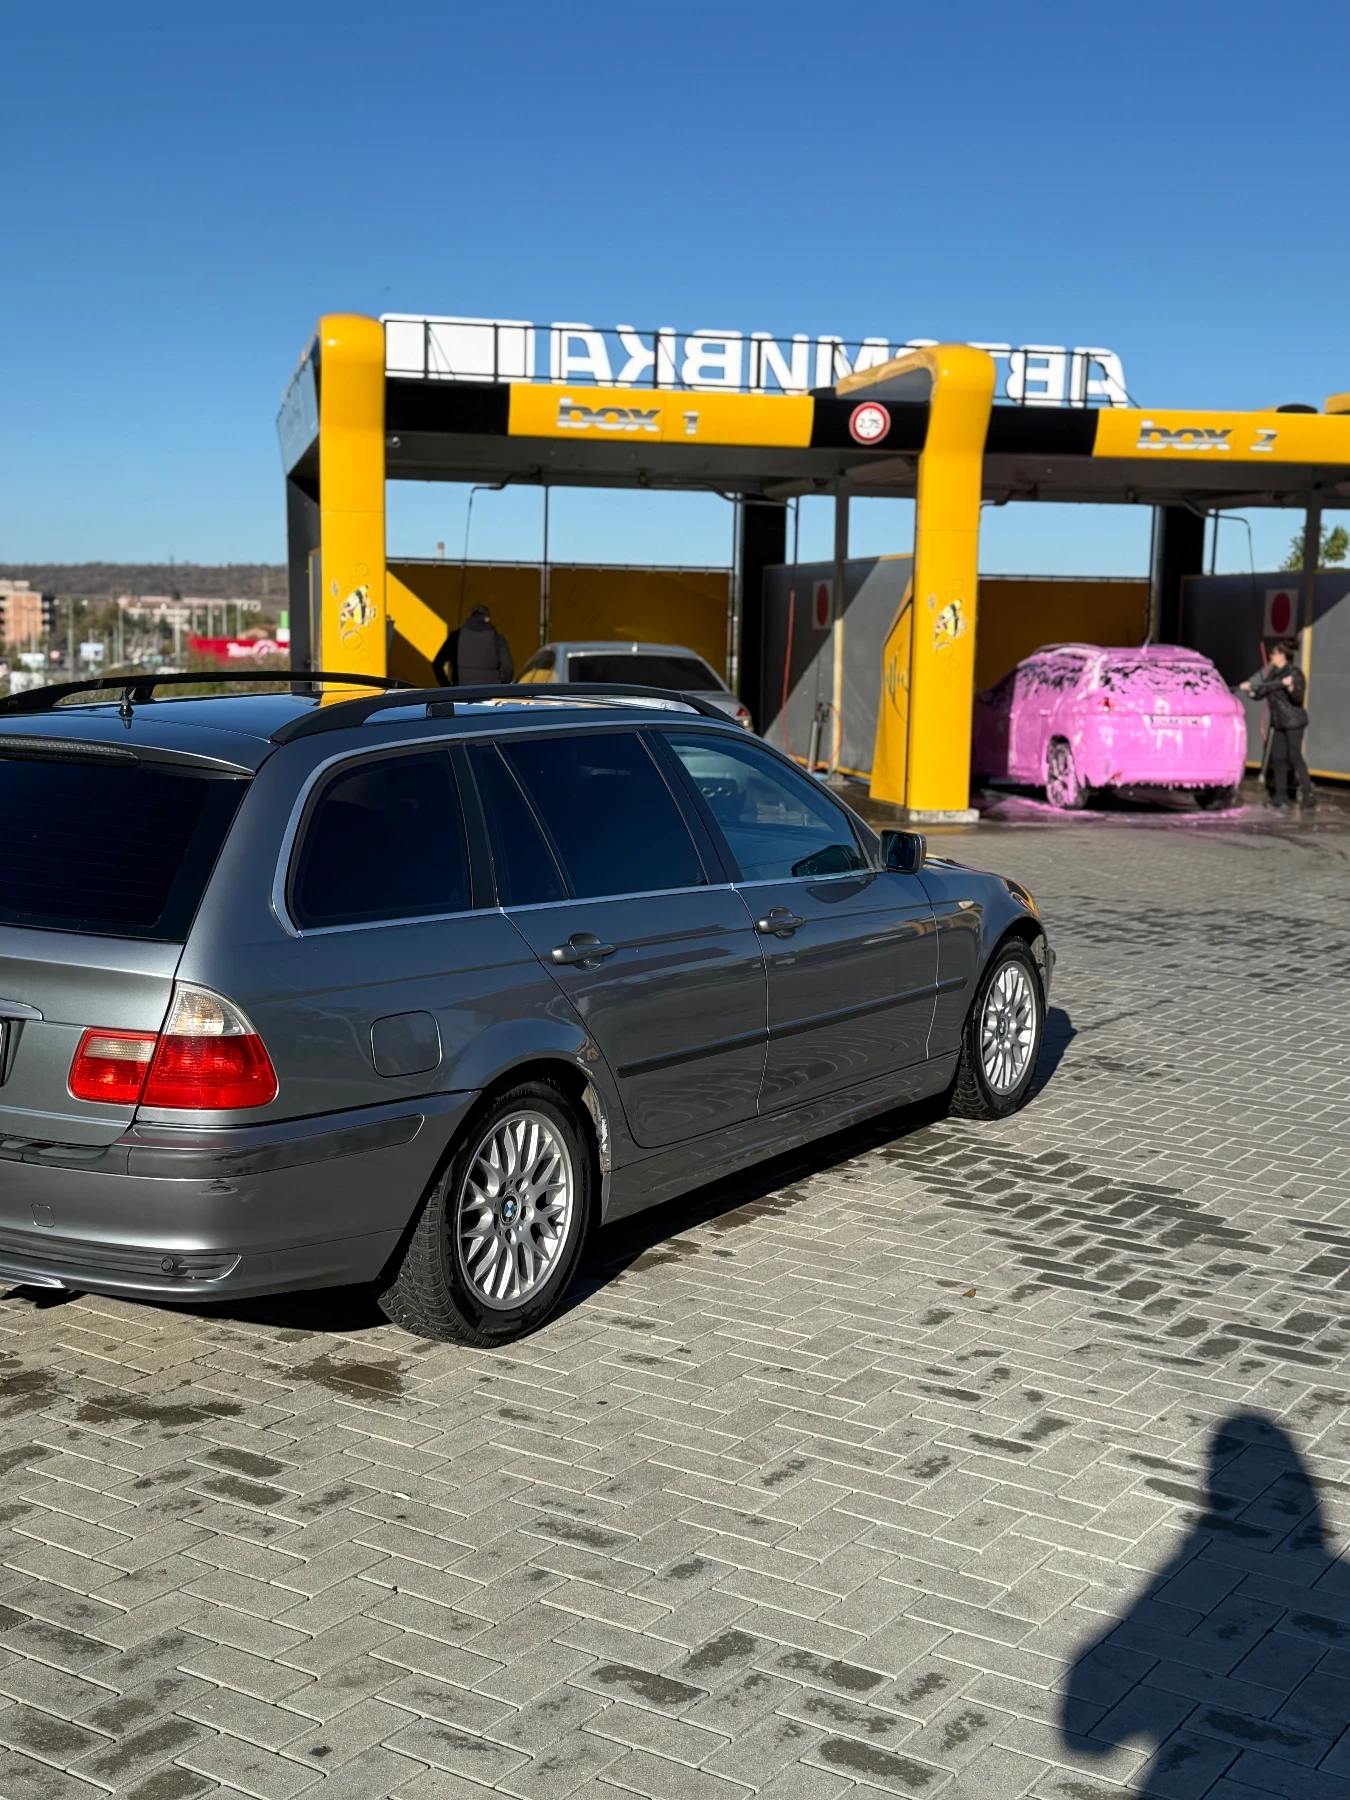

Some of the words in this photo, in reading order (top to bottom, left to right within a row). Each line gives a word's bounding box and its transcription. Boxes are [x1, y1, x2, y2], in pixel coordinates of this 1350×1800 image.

[557, 397, 661, 432] box
[683, 411, 699, 434] 1
[1136, 420, 1233, 450] box
[1249, 428, 1278, 452] 2
